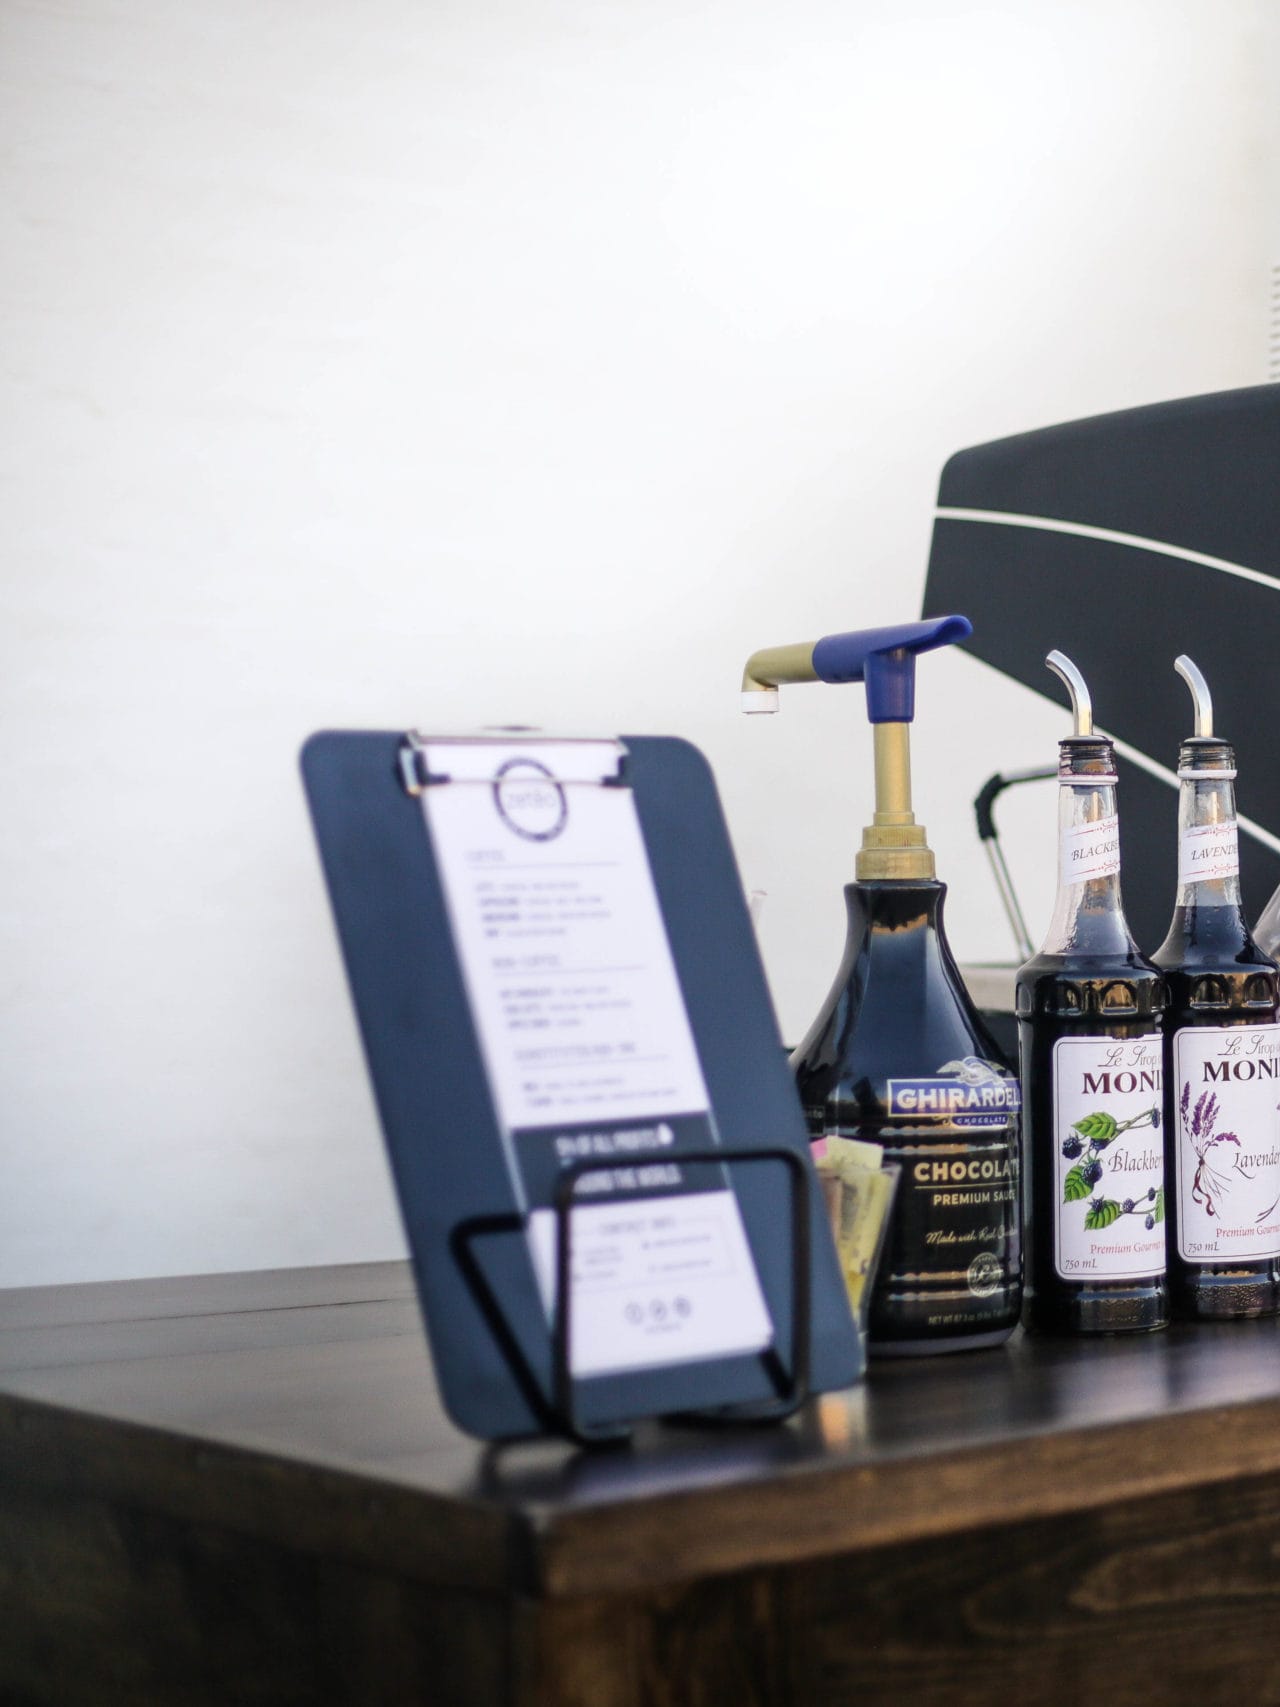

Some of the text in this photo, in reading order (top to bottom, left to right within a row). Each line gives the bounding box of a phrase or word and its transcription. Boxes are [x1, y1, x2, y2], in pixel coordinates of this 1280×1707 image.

[1217, 1035, 1242, 1056] Le
[1097, 1046, 1124, 1068] Le
[1081, 1069, 1162, 1095] MONI
[896, 1086, 1021, 1110] GHIRARDEL
[1108, 1148, 1163, 1173] Blackbe
[933, 1191, 990, 1207] PREMIUM
[925, 1230, 957, 1245] Made
[1216, 1226, 1255, 1238] Premium
[1090, 1242, 1132, 1255] Premium
[1187, 1241, 1220, 1254] 750 mL
[1064, 1258, 1098, 1270] 750 mL
